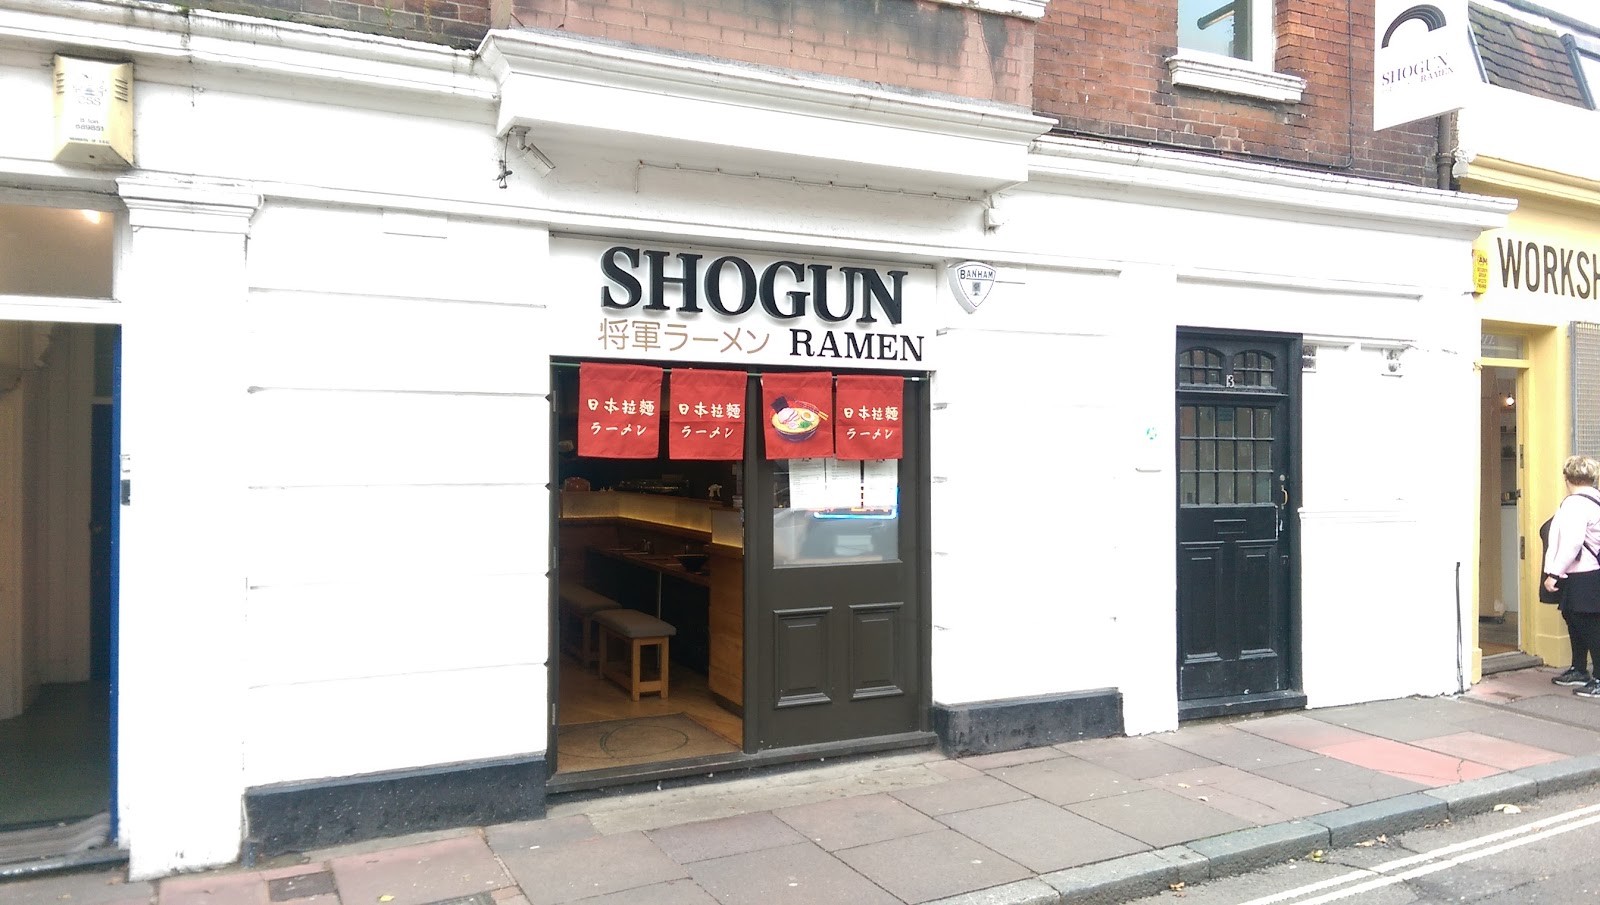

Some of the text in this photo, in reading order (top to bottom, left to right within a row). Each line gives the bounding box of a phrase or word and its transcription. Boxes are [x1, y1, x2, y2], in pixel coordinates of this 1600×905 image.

[1381, 52, 1448, 86] SHOGUN
[960, 269, 994, 280] BANHAM
[600, 246, 909, 325] SHOGUN
[597, 317, 771, 354] 将軍ラーメン
[789, 328, 925, 362] RAMEN
[1225, 374, 1235, 388] 13
[590, 421, 647, 436] ラーメン
[681, 425, 734, 439] ラーメン
[846, 427, 894, 440] ラーメン
